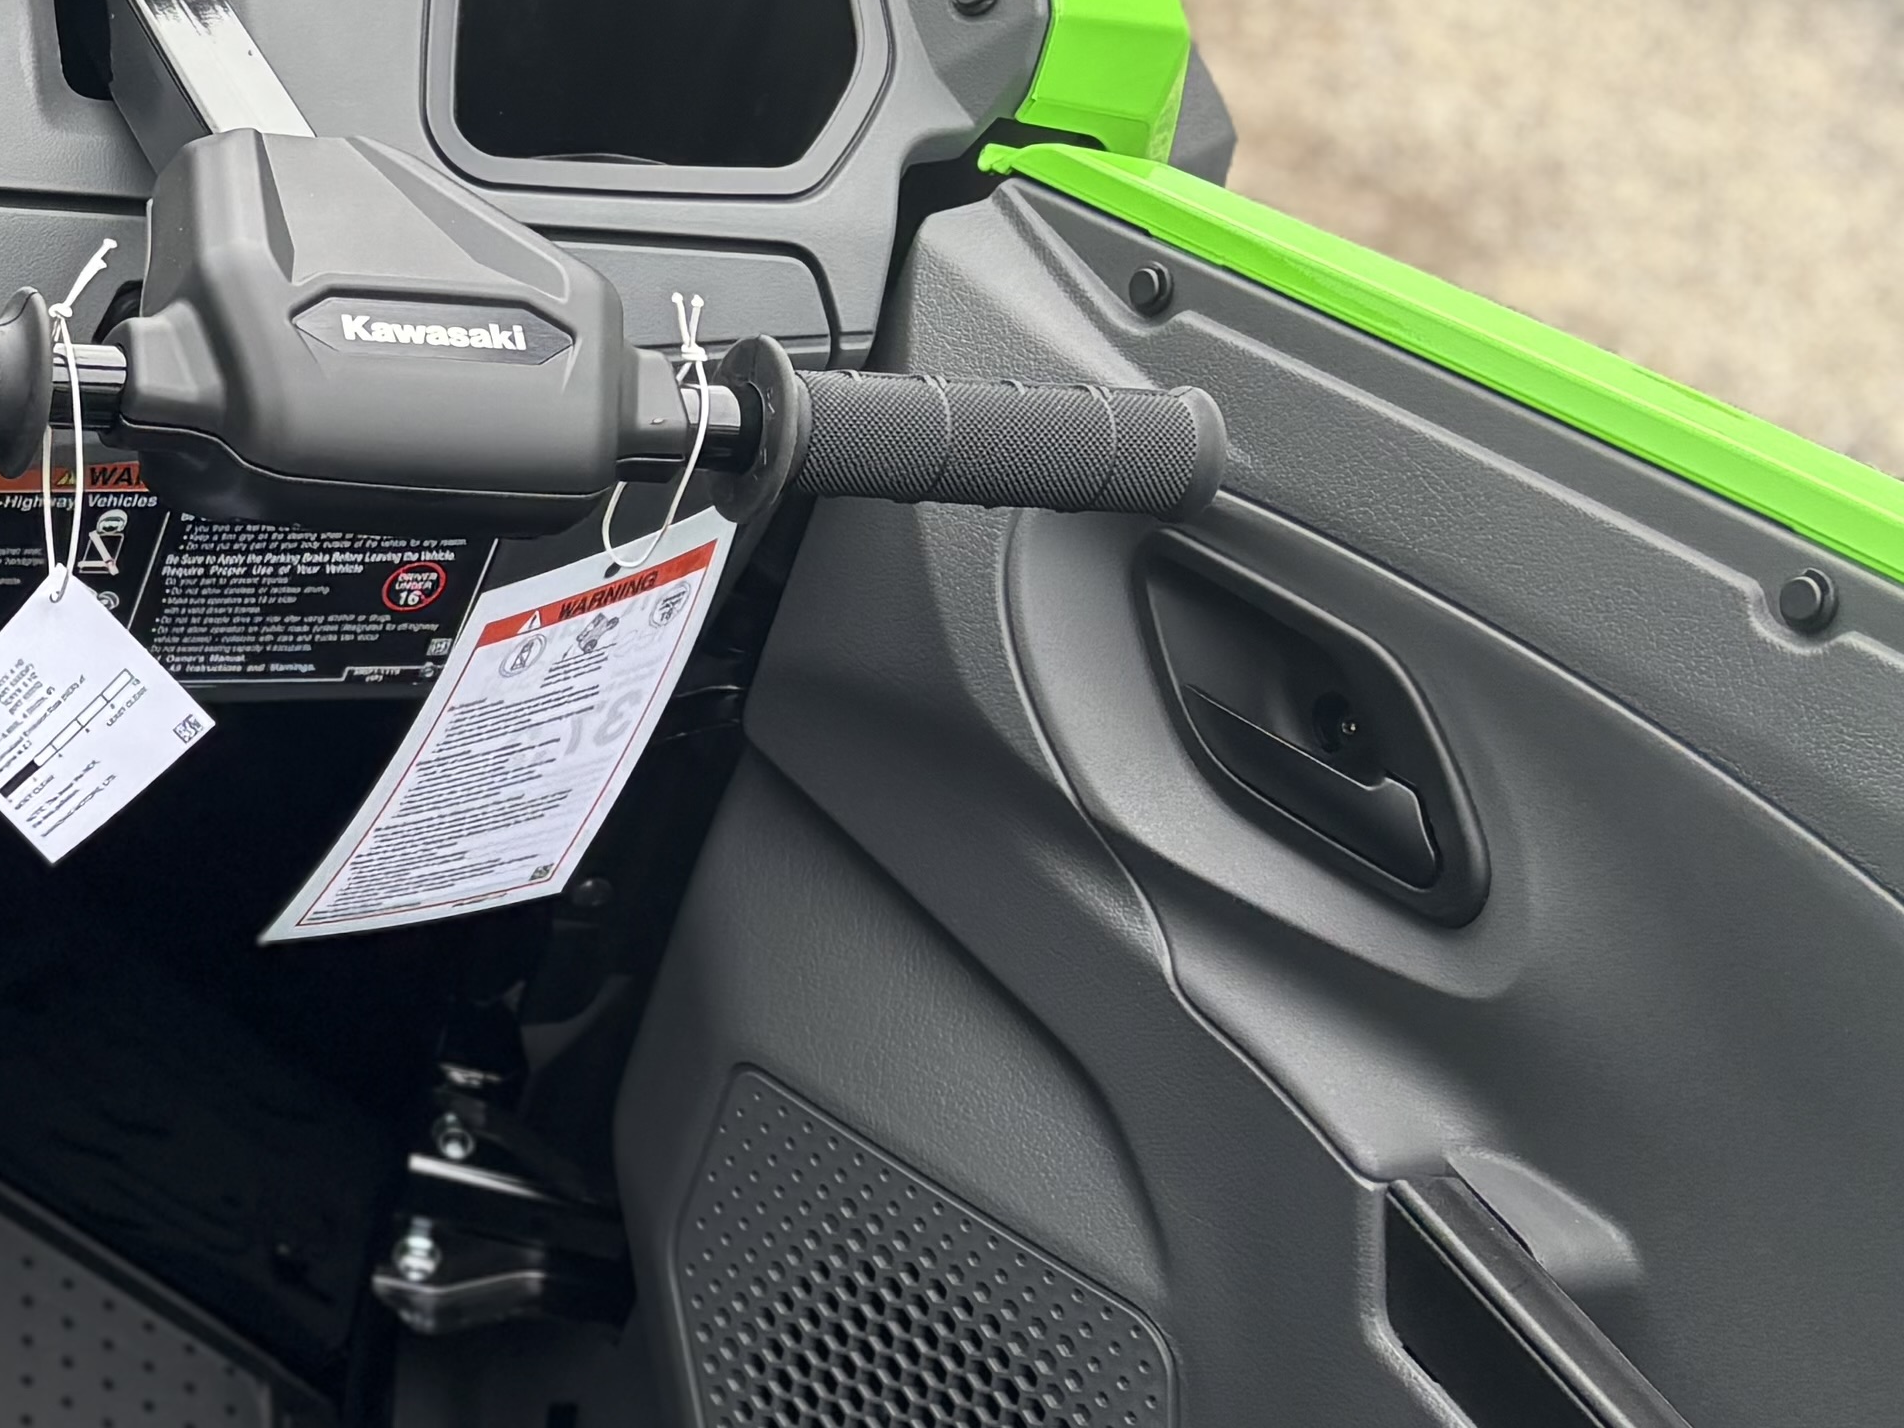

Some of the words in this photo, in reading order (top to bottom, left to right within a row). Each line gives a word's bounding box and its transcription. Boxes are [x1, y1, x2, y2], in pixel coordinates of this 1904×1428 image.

[341, 313, 527, 351] Kawasaki
[90, 466, 141, 486] WA
[88, 493, 158, 508] Vehicles
[180, 554, 205, 565] Sure
[263, 552, 301, 566] Parking
[161, 565, 205, 578] Require
[209, 564, 248, 577] Proper
[252, 564, 274, 576] Use
[278, 564, 292, 576] of
[399, 590, 420, 606] 16
[558, 570, 659, 623] WARNING
